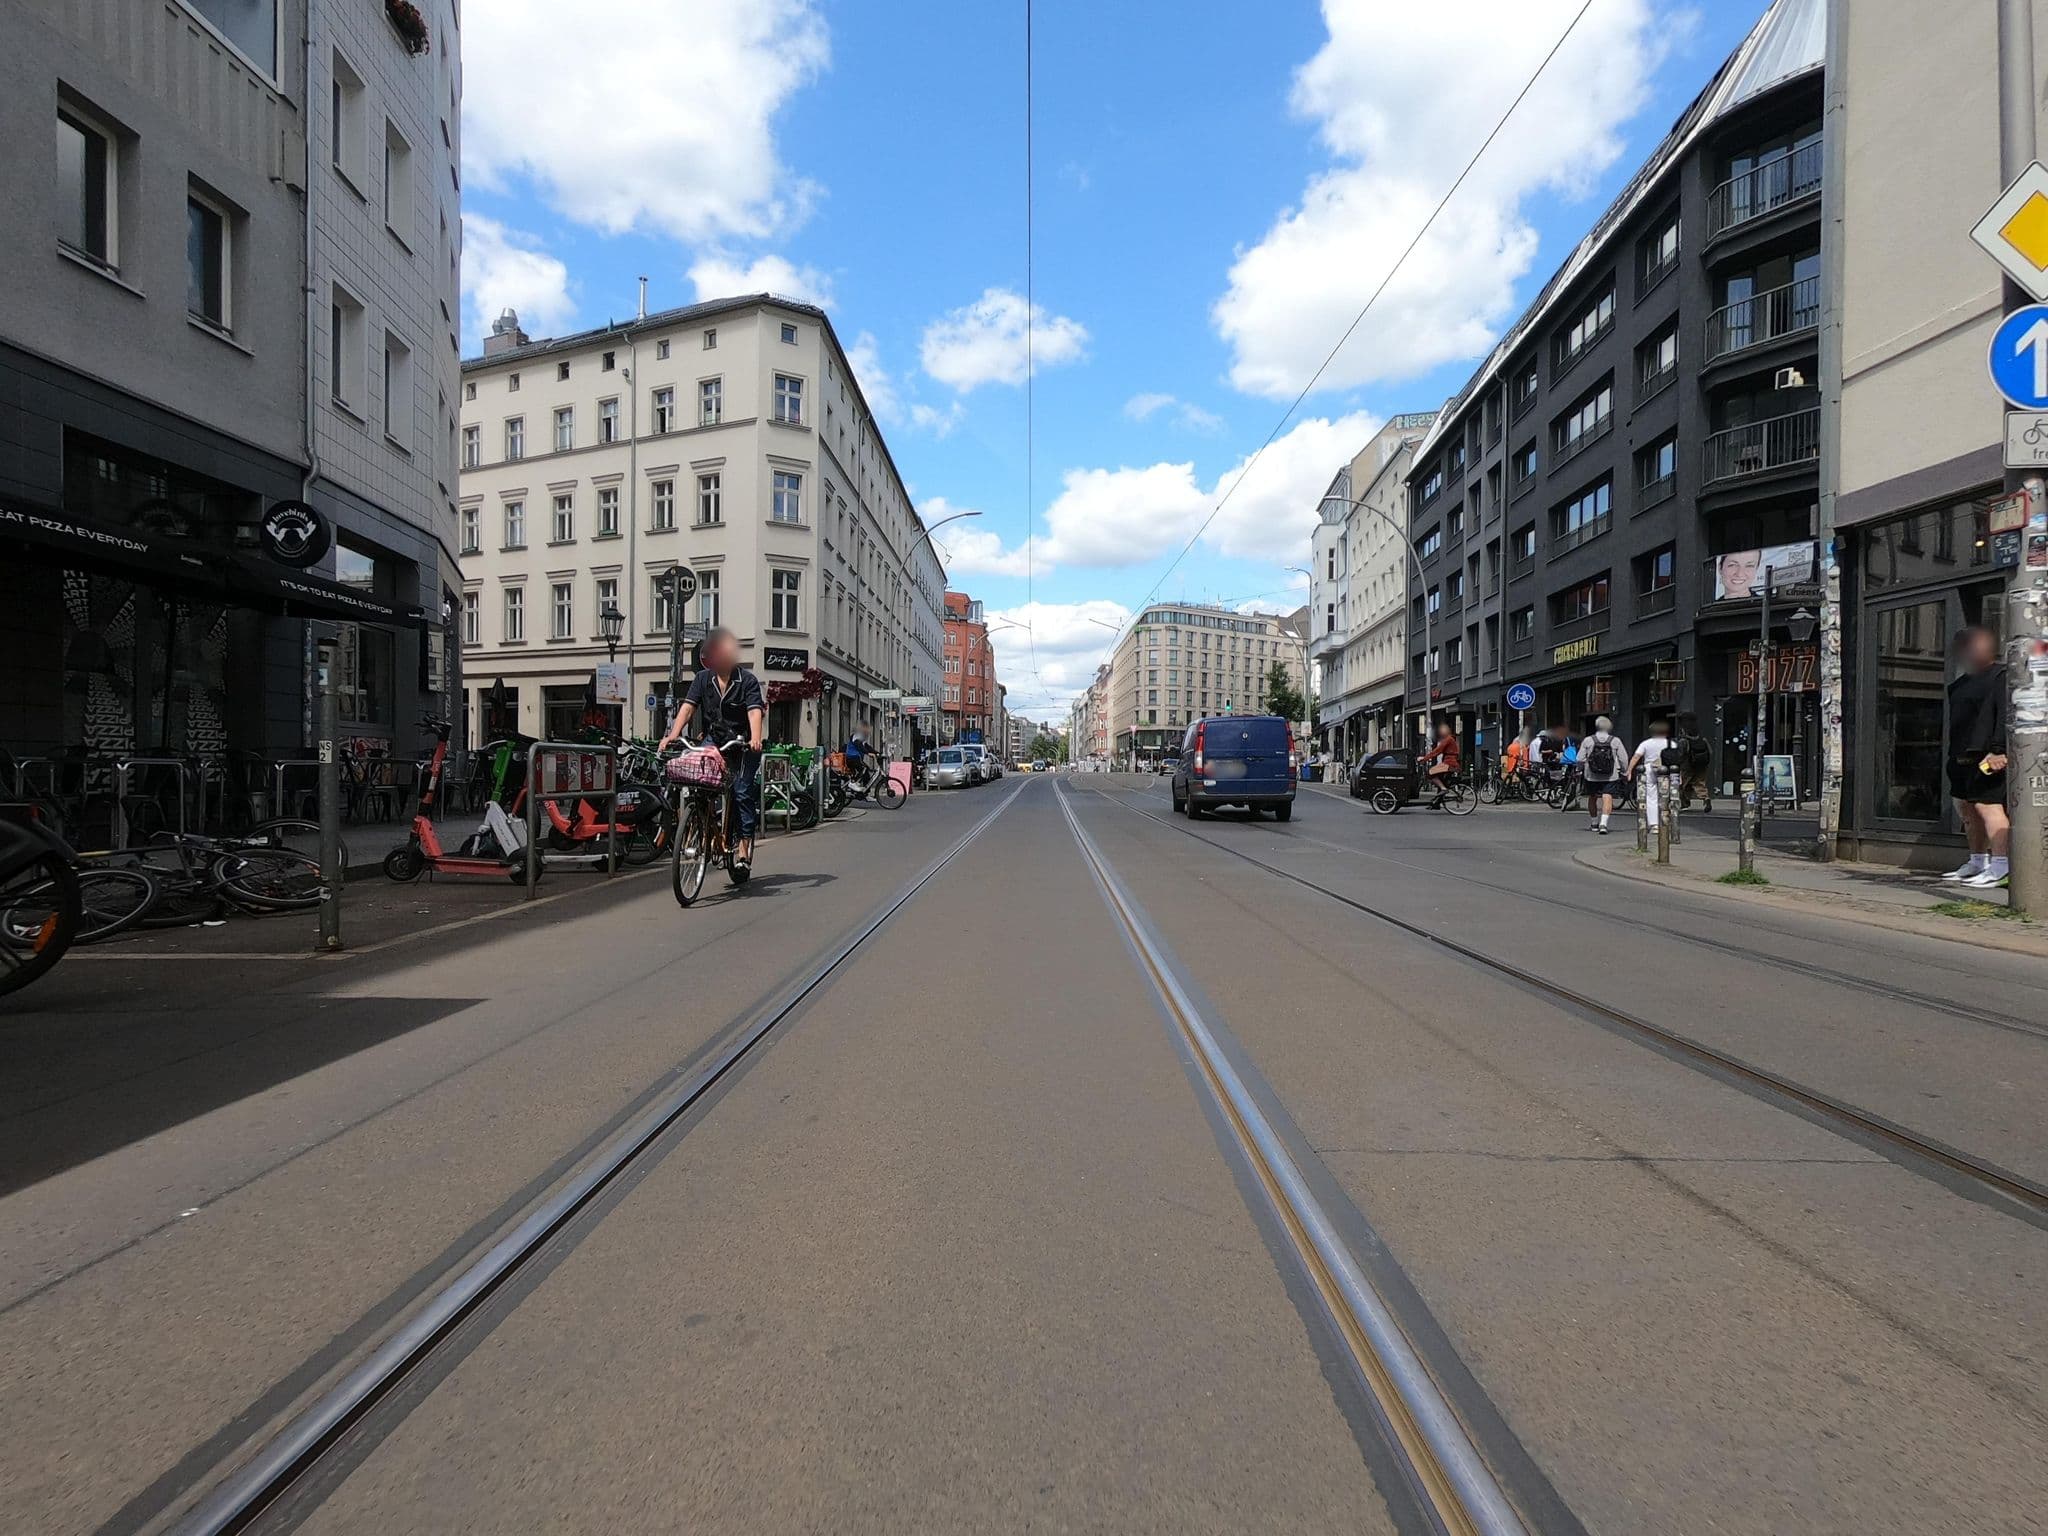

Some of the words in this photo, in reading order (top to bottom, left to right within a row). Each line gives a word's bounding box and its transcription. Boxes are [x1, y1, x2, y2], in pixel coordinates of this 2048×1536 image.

[30, 516, 75, 535] PIZZA
[76, 527, 149, 552] EVERYDAY
[309, 587, 321, 596] TO
[321, 590, 337, 599] EAT
[337, 594, 358, 605] PIZZA
[358, 600, 393, 615] EVERYDAY
[85, 713, 133, 724] PIZZA
[84, 723, 135, 737] PIZZA
[186, 728, 228, 740] PIZZA
